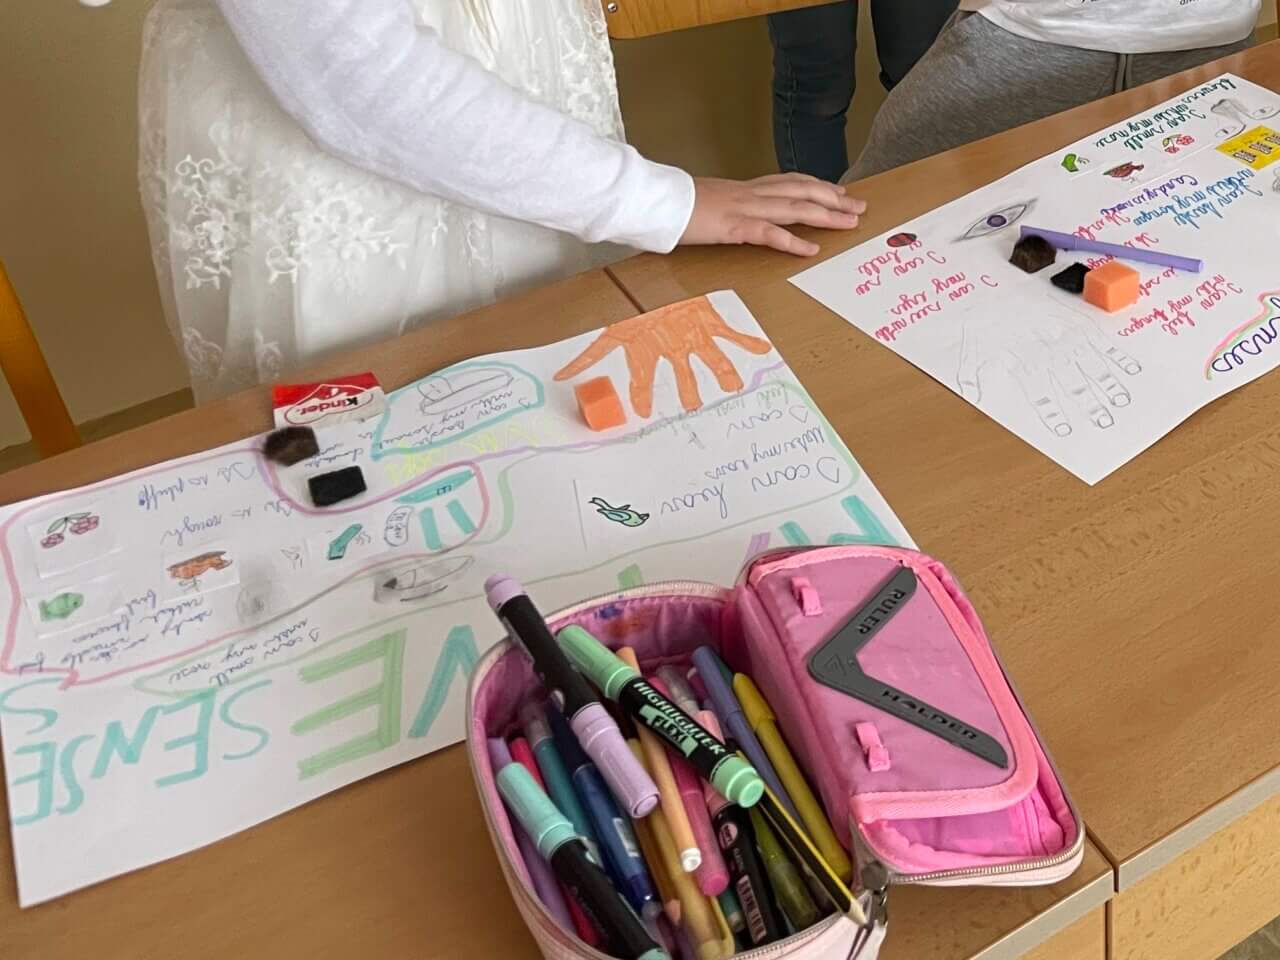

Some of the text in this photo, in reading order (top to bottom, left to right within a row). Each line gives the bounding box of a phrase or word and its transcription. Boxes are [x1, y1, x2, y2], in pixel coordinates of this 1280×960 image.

[857, 249, 902, 277] ball
[893, 256, 925, 277] can
[855, 274, 882, 296] see
[948, 283, 976, 302] can
[1199, 286, 1228, 310] can
[909, 300, 942, 324] see
[659, 455, 841, 520] I can hear
[857, 588, 906, 636] RULER
[263, 639, 298, 660] can
[651, 712, 690, 748] FLEXI
